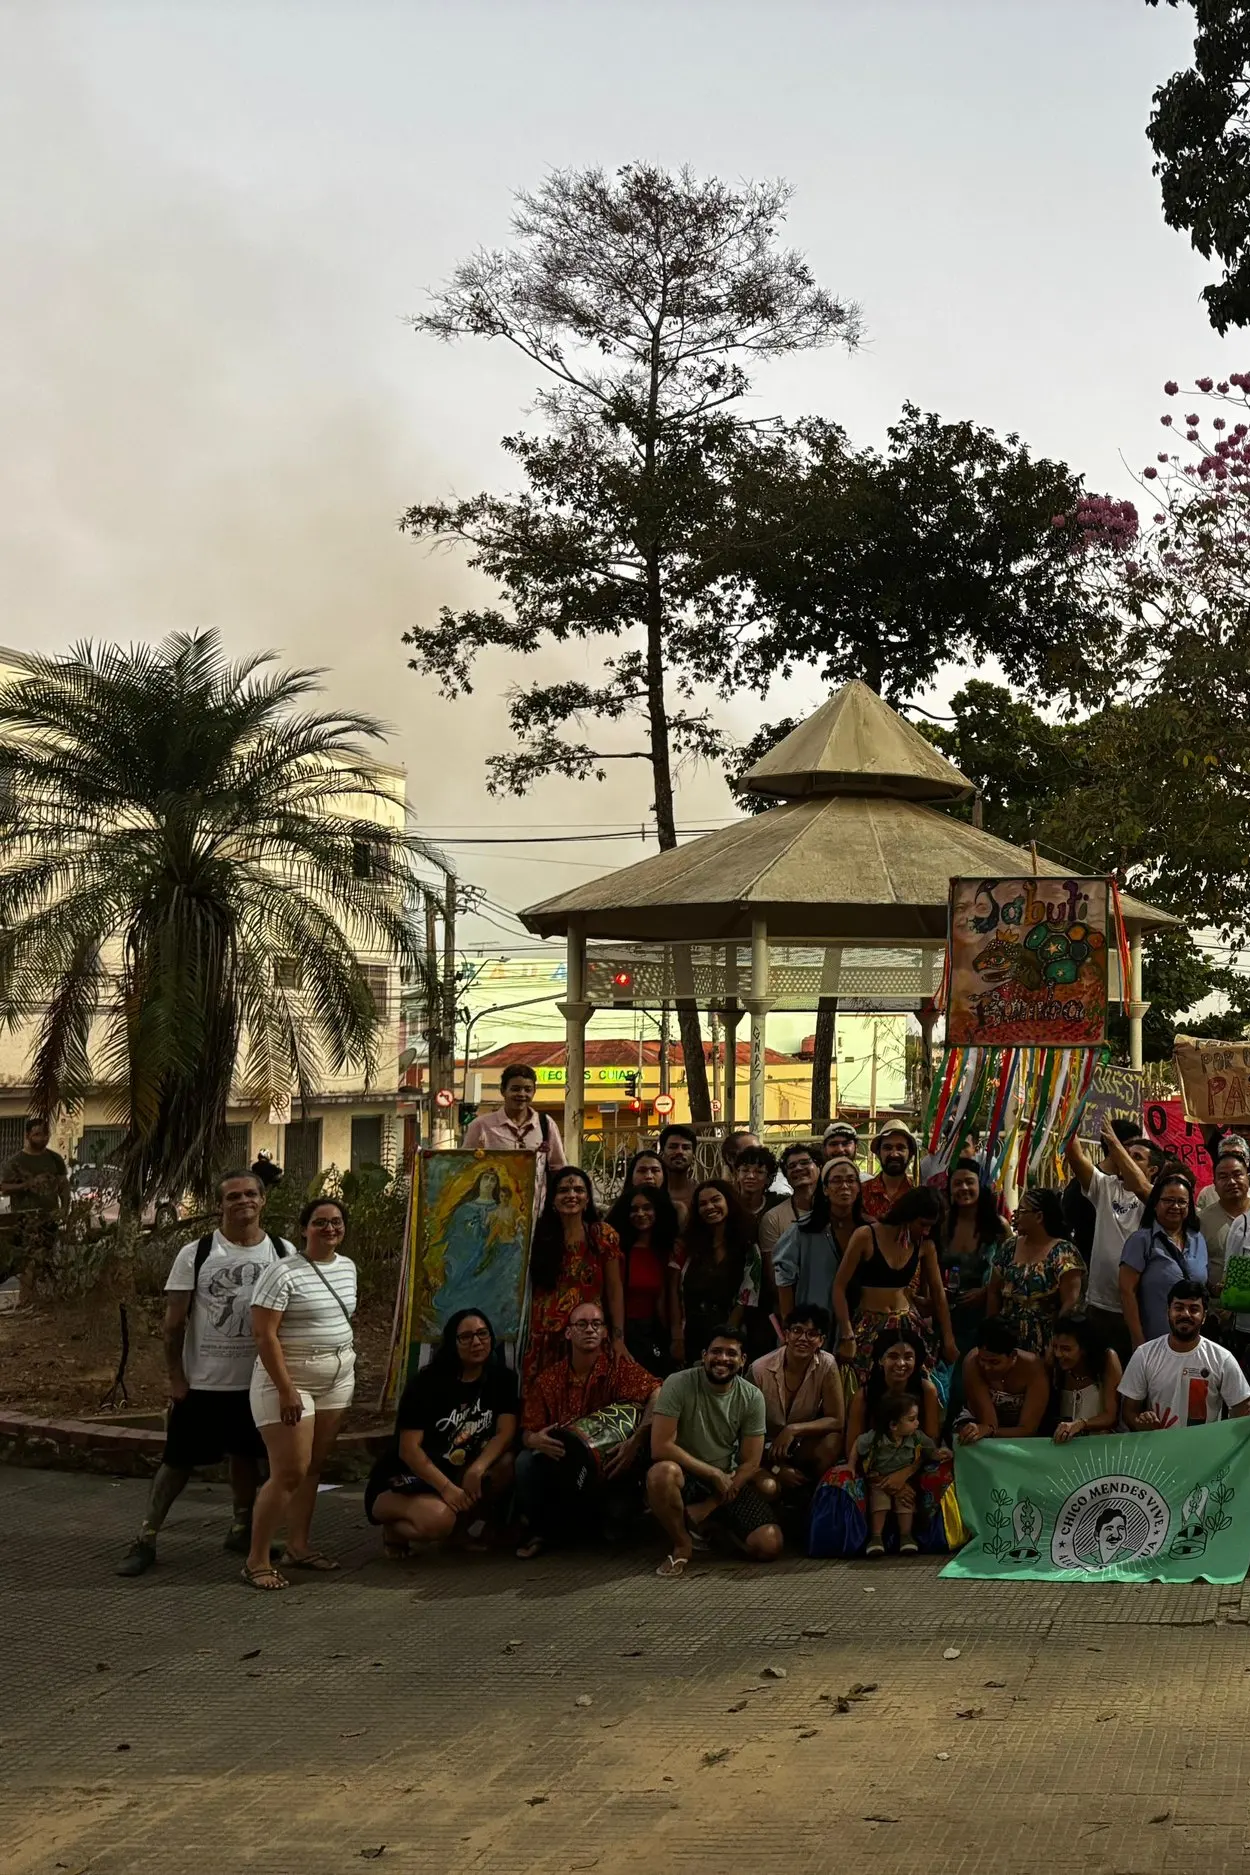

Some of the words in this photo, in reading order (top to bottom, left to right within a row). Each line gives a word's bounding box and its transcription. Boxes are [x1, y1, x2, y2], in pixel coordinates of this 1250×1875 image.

[1200, 1050, 1234, 1073] POR
[1061, 1496, 1087, 1536] CHICO
[1088, 1482, 1148, 1500] MENDES
[1146, 1496, 1165, 1528] VIVE
